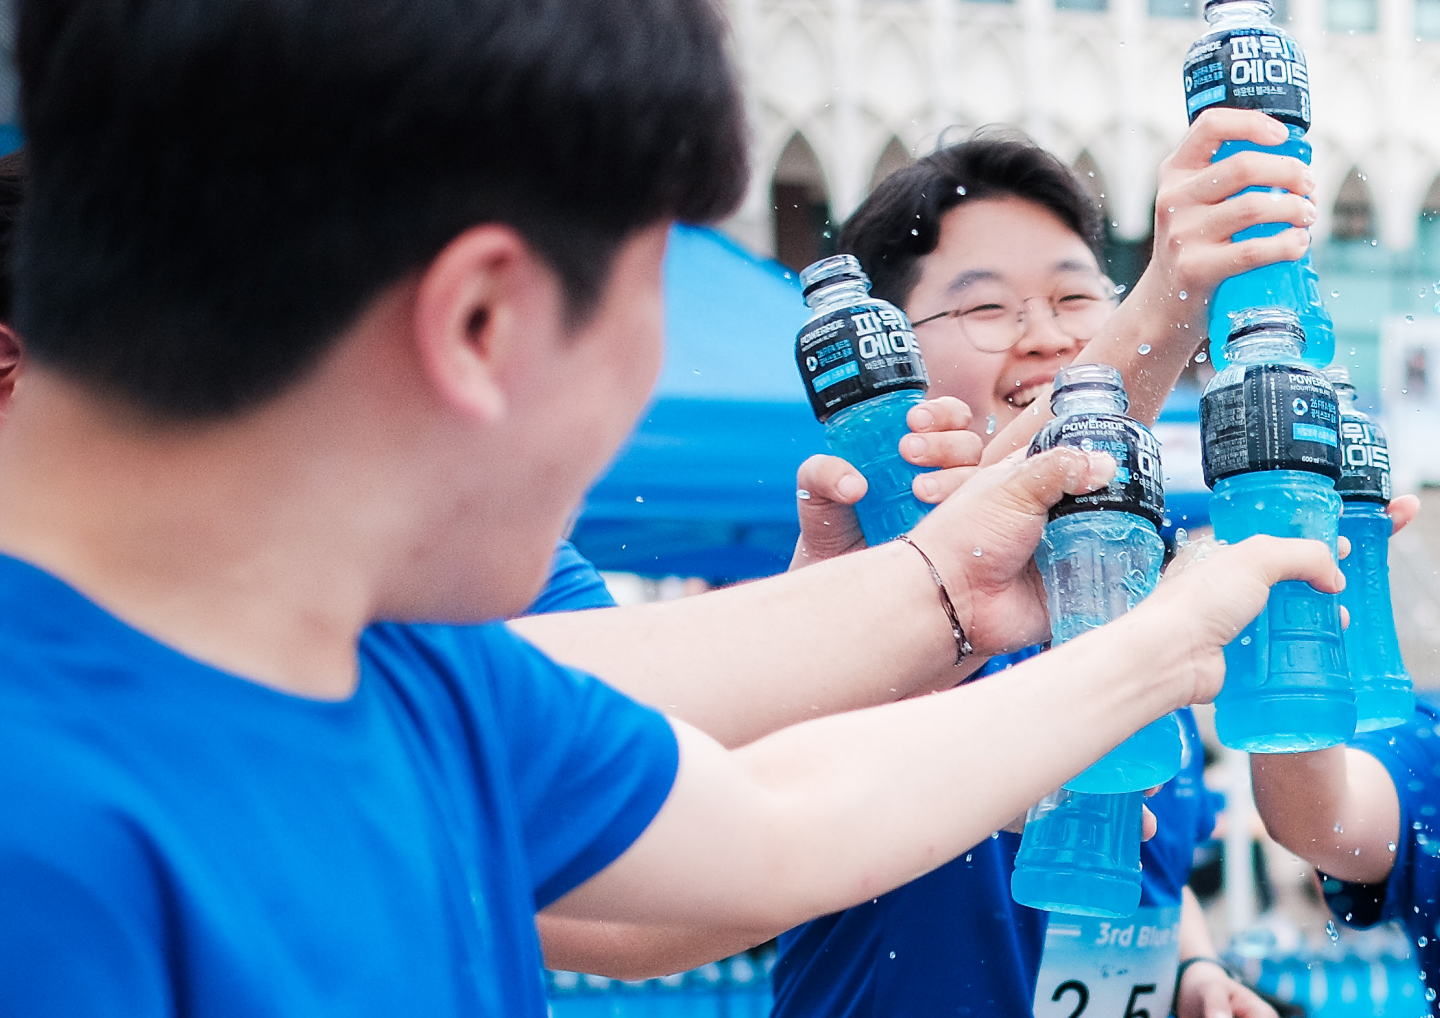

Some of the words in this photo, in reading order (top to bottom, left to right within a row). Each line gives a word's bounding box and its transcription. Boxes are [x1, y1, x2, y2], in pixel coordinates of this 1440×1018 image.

[1231, 59, 1309, 89] 에이드
[1062, 420, 1126, 433] POWERADE
[1341, 444, 1389, 472] 이드
